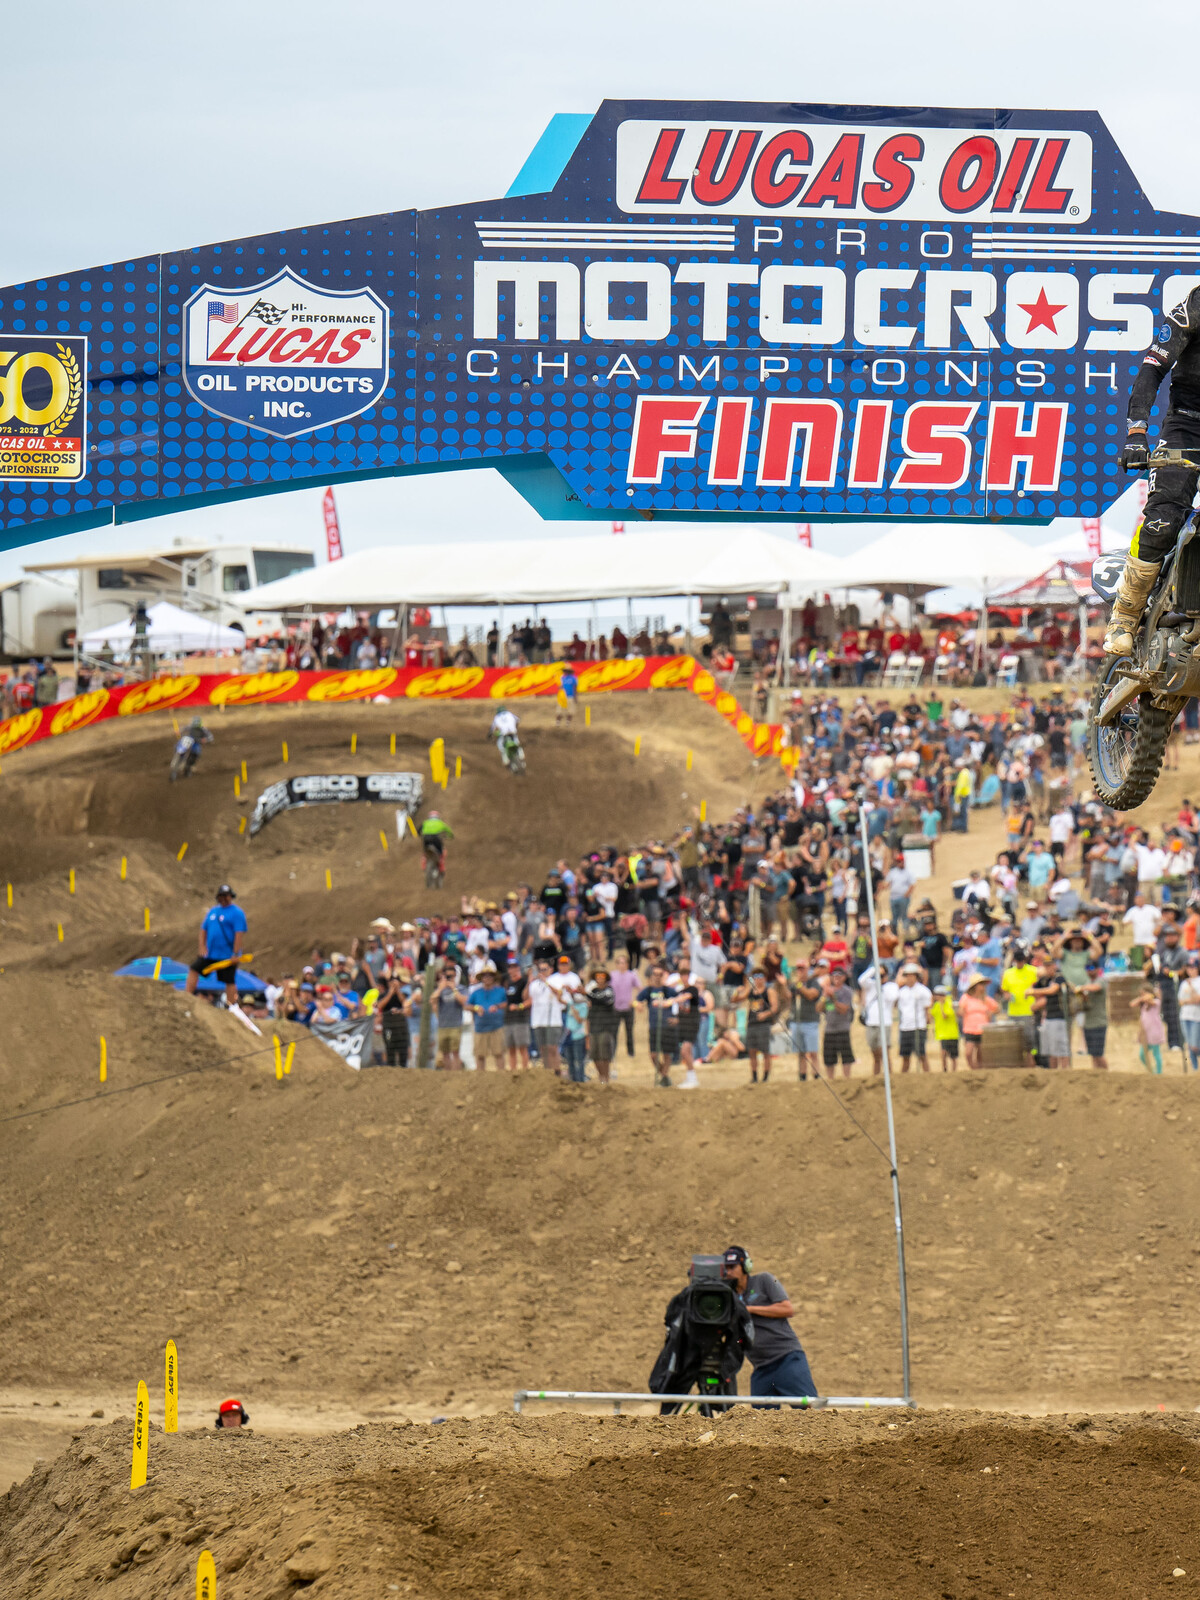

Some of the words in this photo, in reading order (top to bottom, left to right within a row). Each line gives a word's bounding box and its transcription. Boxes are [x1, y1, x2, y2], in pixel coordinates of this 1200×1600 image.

[634, 128, 925, 213] LUCAS
[938, 135, 1074, 214] OIL
[753, 225, 954, 259] PRO
[291, 303, 307, 311] HI-
[291, 314, 376, 323] PERFORMANCE
[207, 327, 372, 364] LUCAS
[197, 374, 238, 391] OIL
[245, 375, 374, 393] PRODUCTS
[467, 349, 1118, 389] CHAMPIONSH
[0, 438, 25, 449] CAS
[27, 438, 46, 450] OIL
[626, 395, 1069, 491] FINISH
[0, 465, 60, 474] MPIONSHIP
[136, 1400, 144, 1450] ACERBIS
